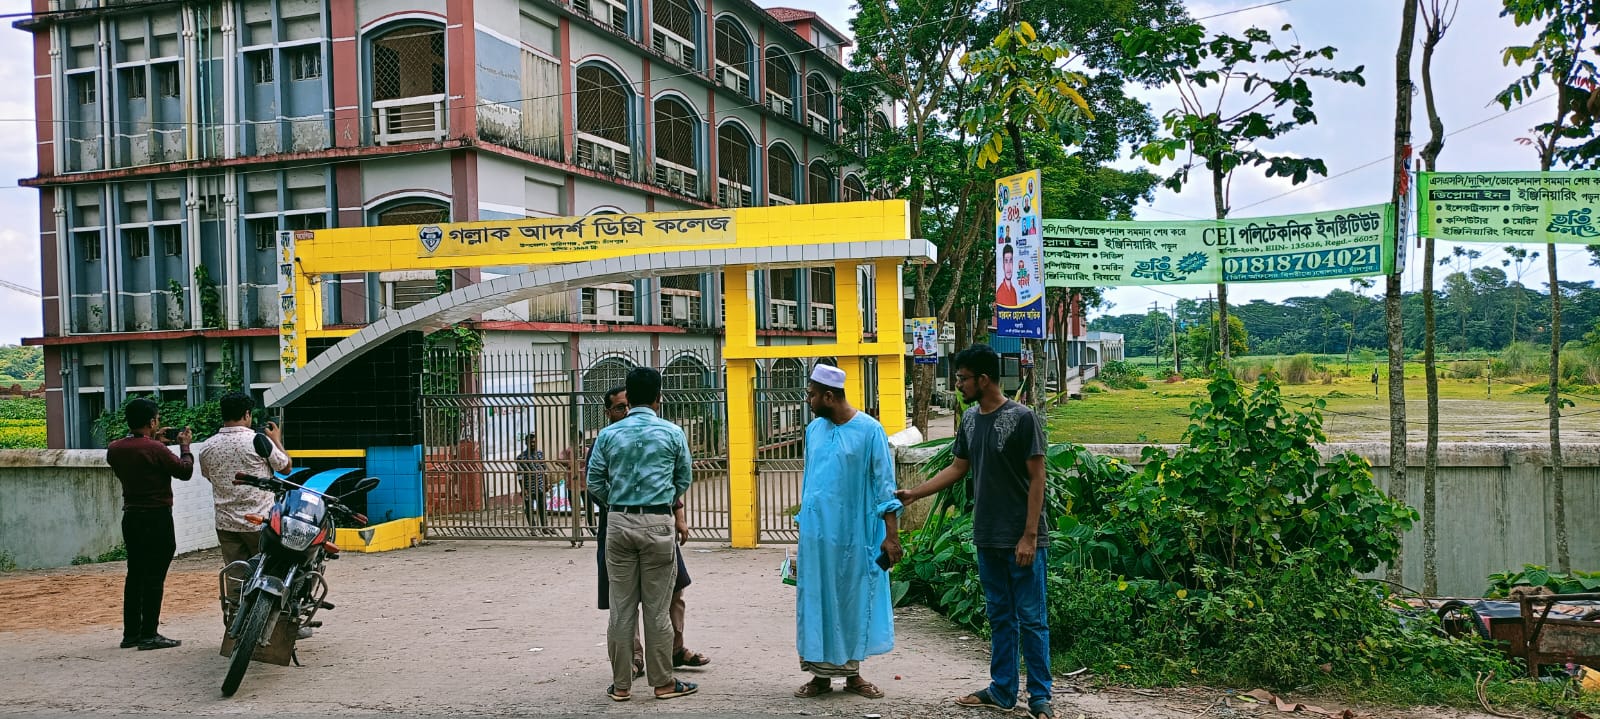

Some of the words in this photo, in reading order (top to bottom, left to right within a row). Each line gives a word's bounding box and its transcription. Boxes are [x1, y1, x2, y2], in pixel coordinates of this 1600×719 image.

[1574, 178, 1590, 186] শেষ
[1432, 190, 1479, 200] ডিপ্লোমা
[1517, 188, 1577, 202] ইঞ্জিনিয়ারিং
[1512, 204, 1539, 213] সিভিল
[1512, 216, 1539, 225] মেরিন
[449, 226, 512, 244] গল্লাক
[518, 218, 585, 242] আদর্শ
[592, 216, 646, 238] ডিগ্রি
[652, 216, 731, 236] কলেজ
[1170, 228, 1186, 236] করে
[1203, 226, 1236, 246] CEI
[1239, 220, 1313, 245] পলিটেকনিক
[1043, 239, 1070, 247] প্লোমা
[1104, 237, 1157, 250] ইঞ্জিনিয়ারিং
[1354, 235, 1379, 243] 66057
[1100, 252, 1124, 260] সিভিল
[1224, 247, 1377, 275] 01818704021
[1101, 263, 1124, 272] মেরিন
[1045, 272, 1090, 281] ঞ্জিনিয়ারিং
